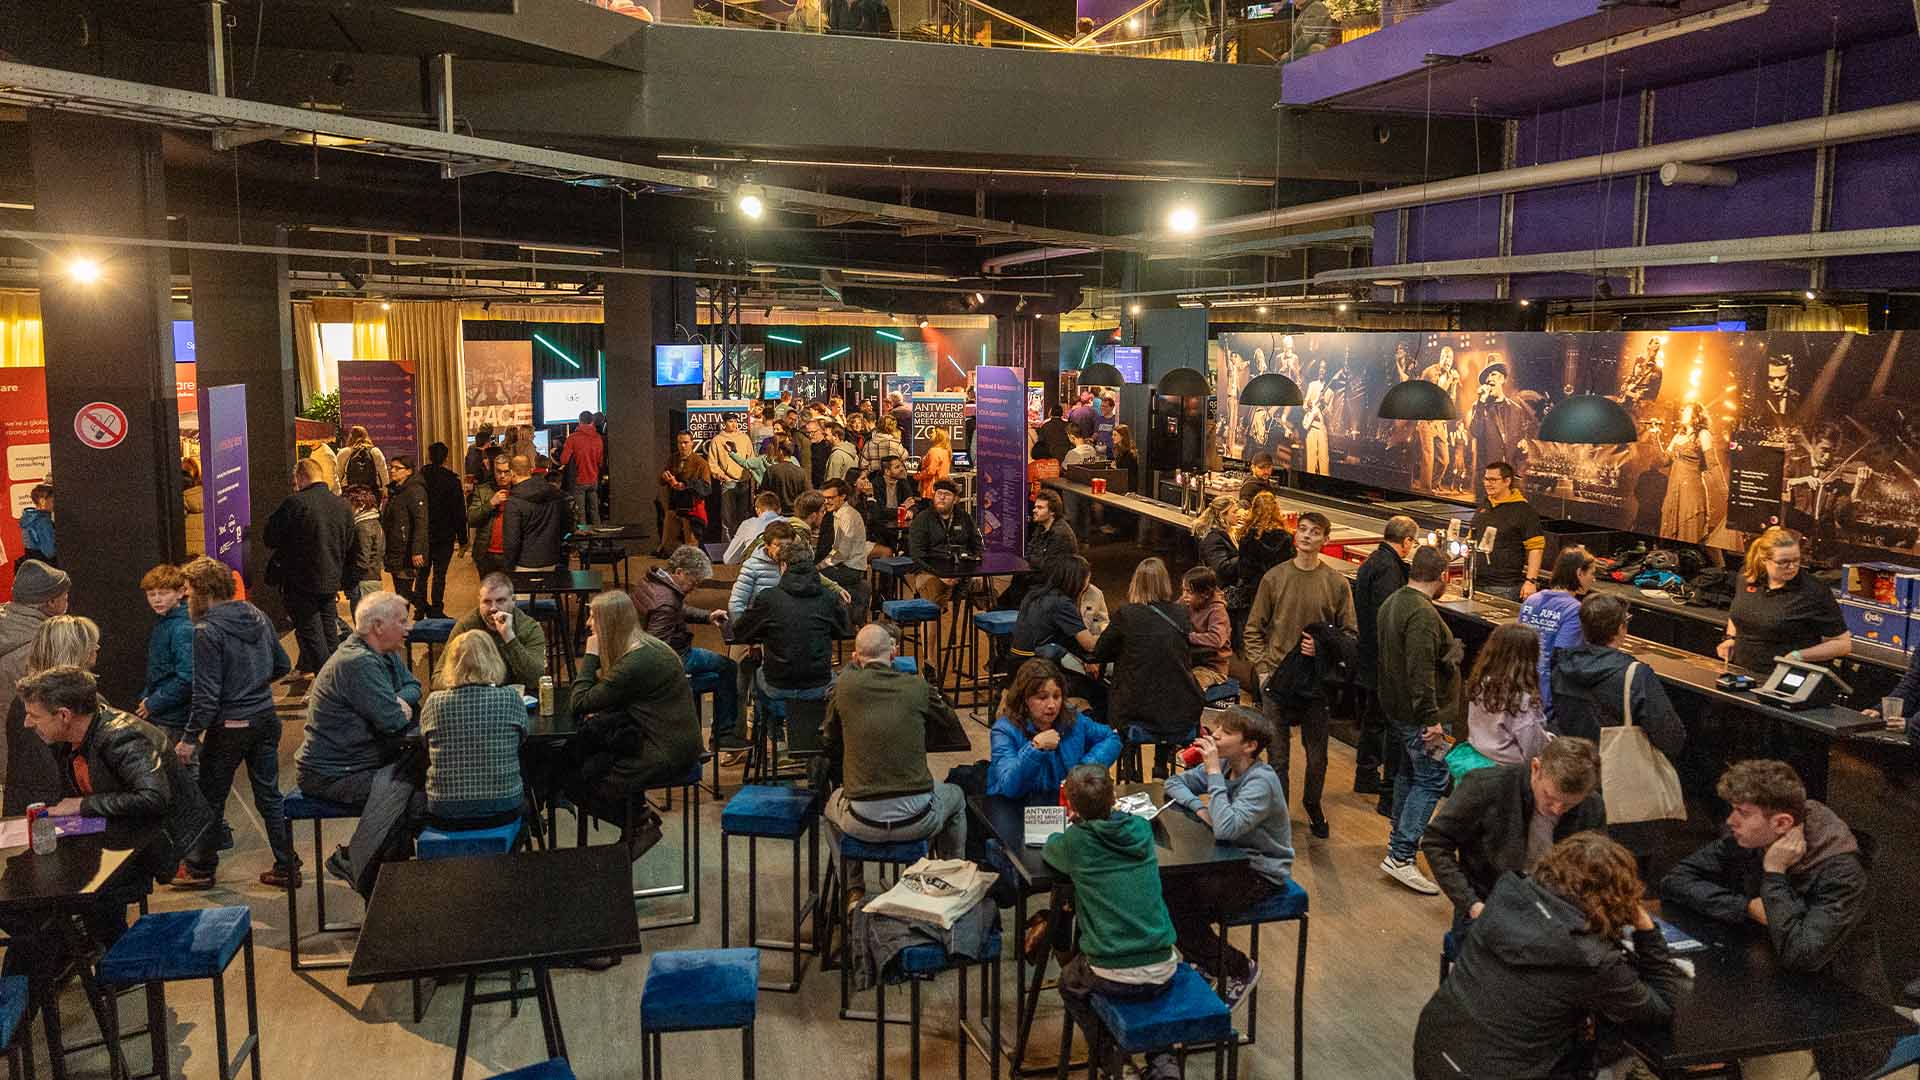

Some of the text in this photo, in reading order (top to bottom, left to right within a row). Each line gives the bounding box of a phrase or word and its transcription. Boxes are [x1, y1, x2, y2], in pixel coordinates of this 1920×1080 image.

[914, 403, 964, 412] ANTWERP
[914, 411, 938, 419] GREAT
[690, 423, 718, 431] GREAT
